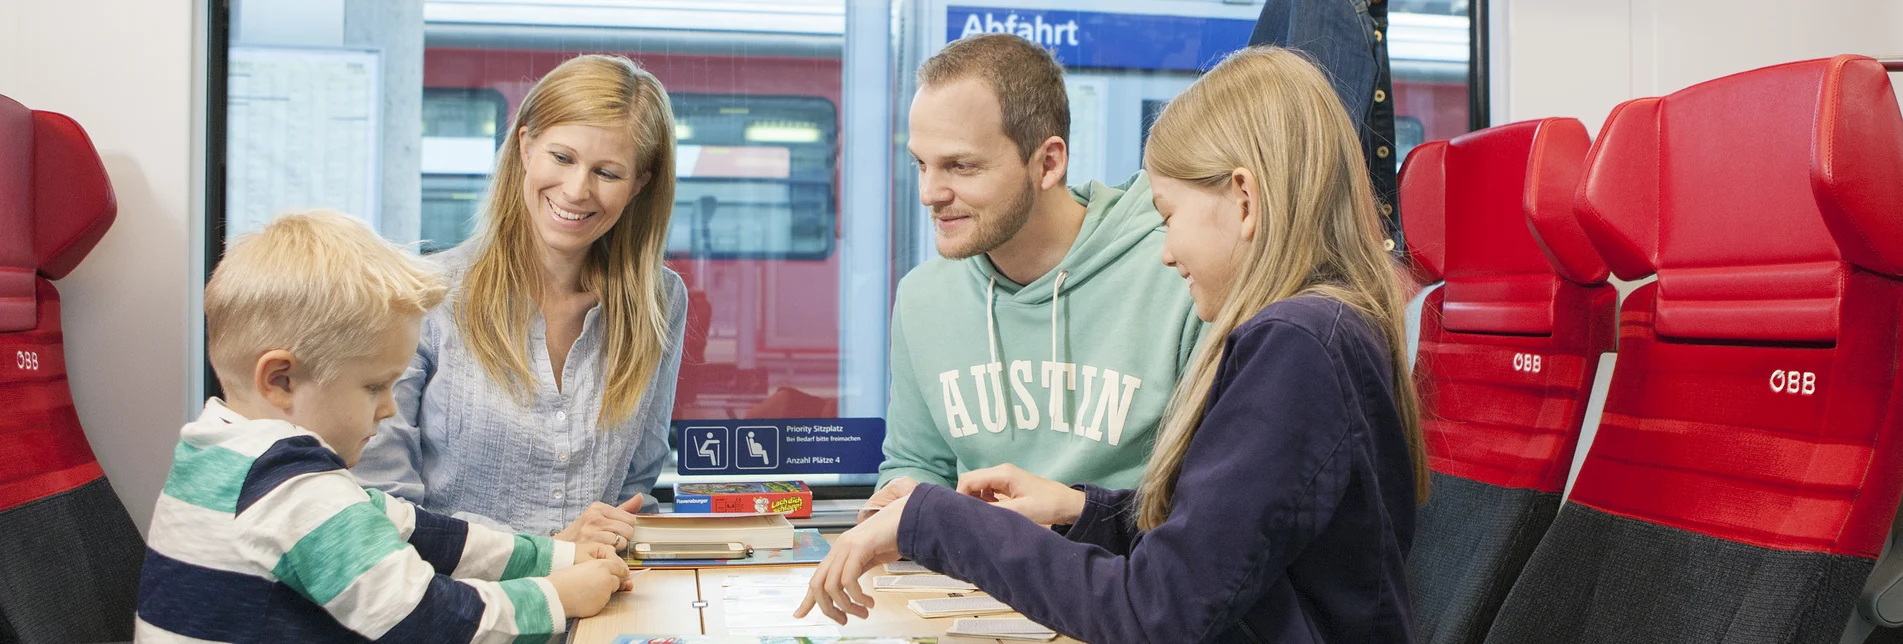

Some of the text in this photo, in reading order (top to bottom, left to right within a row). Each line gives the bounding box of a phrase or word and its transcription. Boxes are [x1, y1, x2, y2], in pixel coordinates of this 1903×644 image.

[961, 12, 1079, 46] Abfahrt
[939, 359, 1142, 446] AUSTIN
[786, 424, 844, 434] Priority Sitzplatz
[812, 456, 834, 464] Plätze
[835, 456, 841, 464] 4
[771, 495, 803, 509] Lach dich
